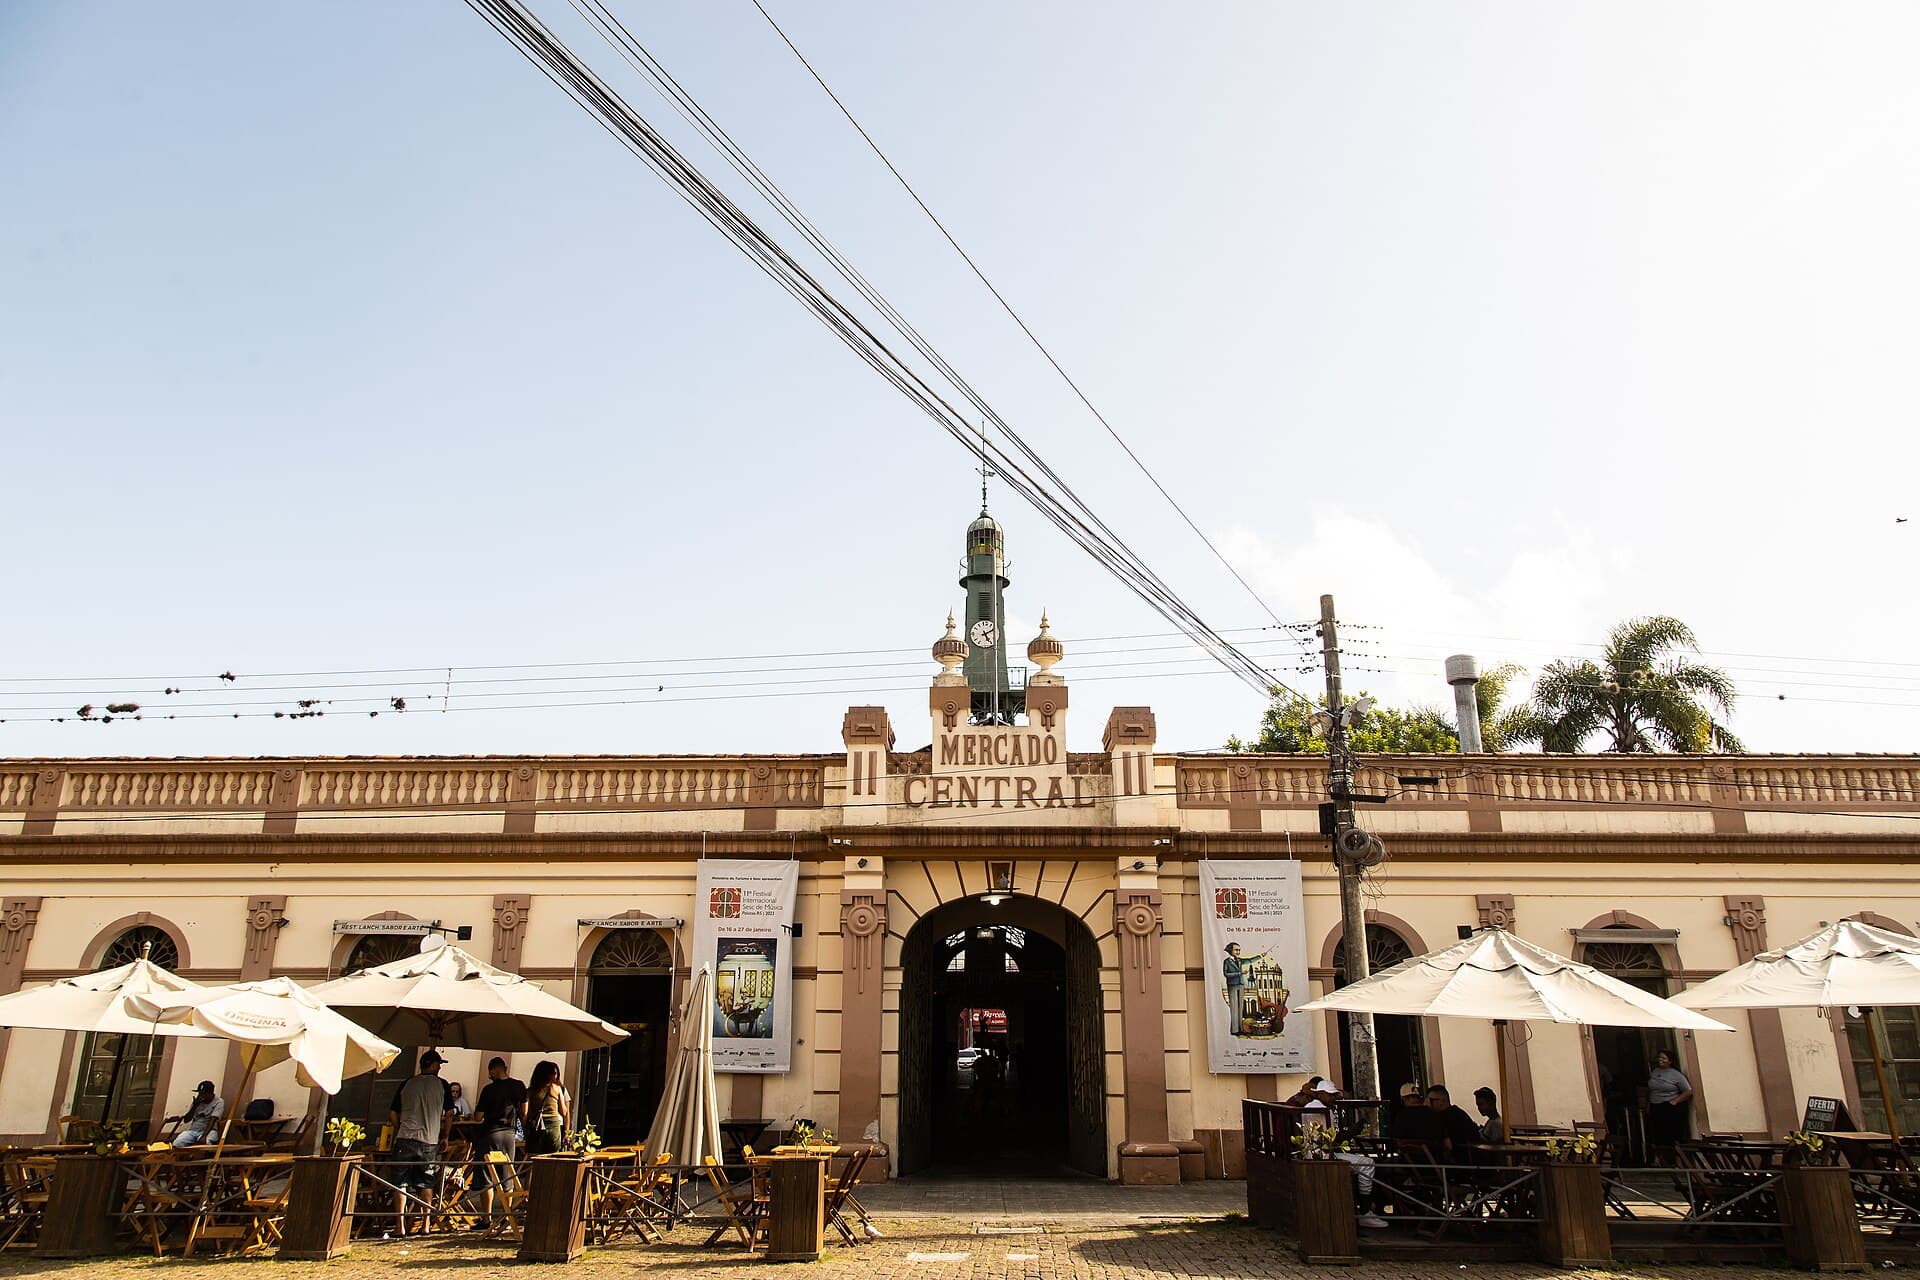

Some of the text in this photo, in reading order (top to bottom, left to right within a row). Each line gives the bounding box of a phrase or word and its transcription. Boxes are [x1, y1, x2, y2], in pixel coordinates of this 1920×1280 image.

[940, 734, 1057, 765] MERCADO
[904, 775, 1096, 809] CENTRAL
[764, 903, 783, 911] Música
[224, 1011, 287, 1027] ORIGINAL
[1809, 1099, 1835, 1110] OFERTA
